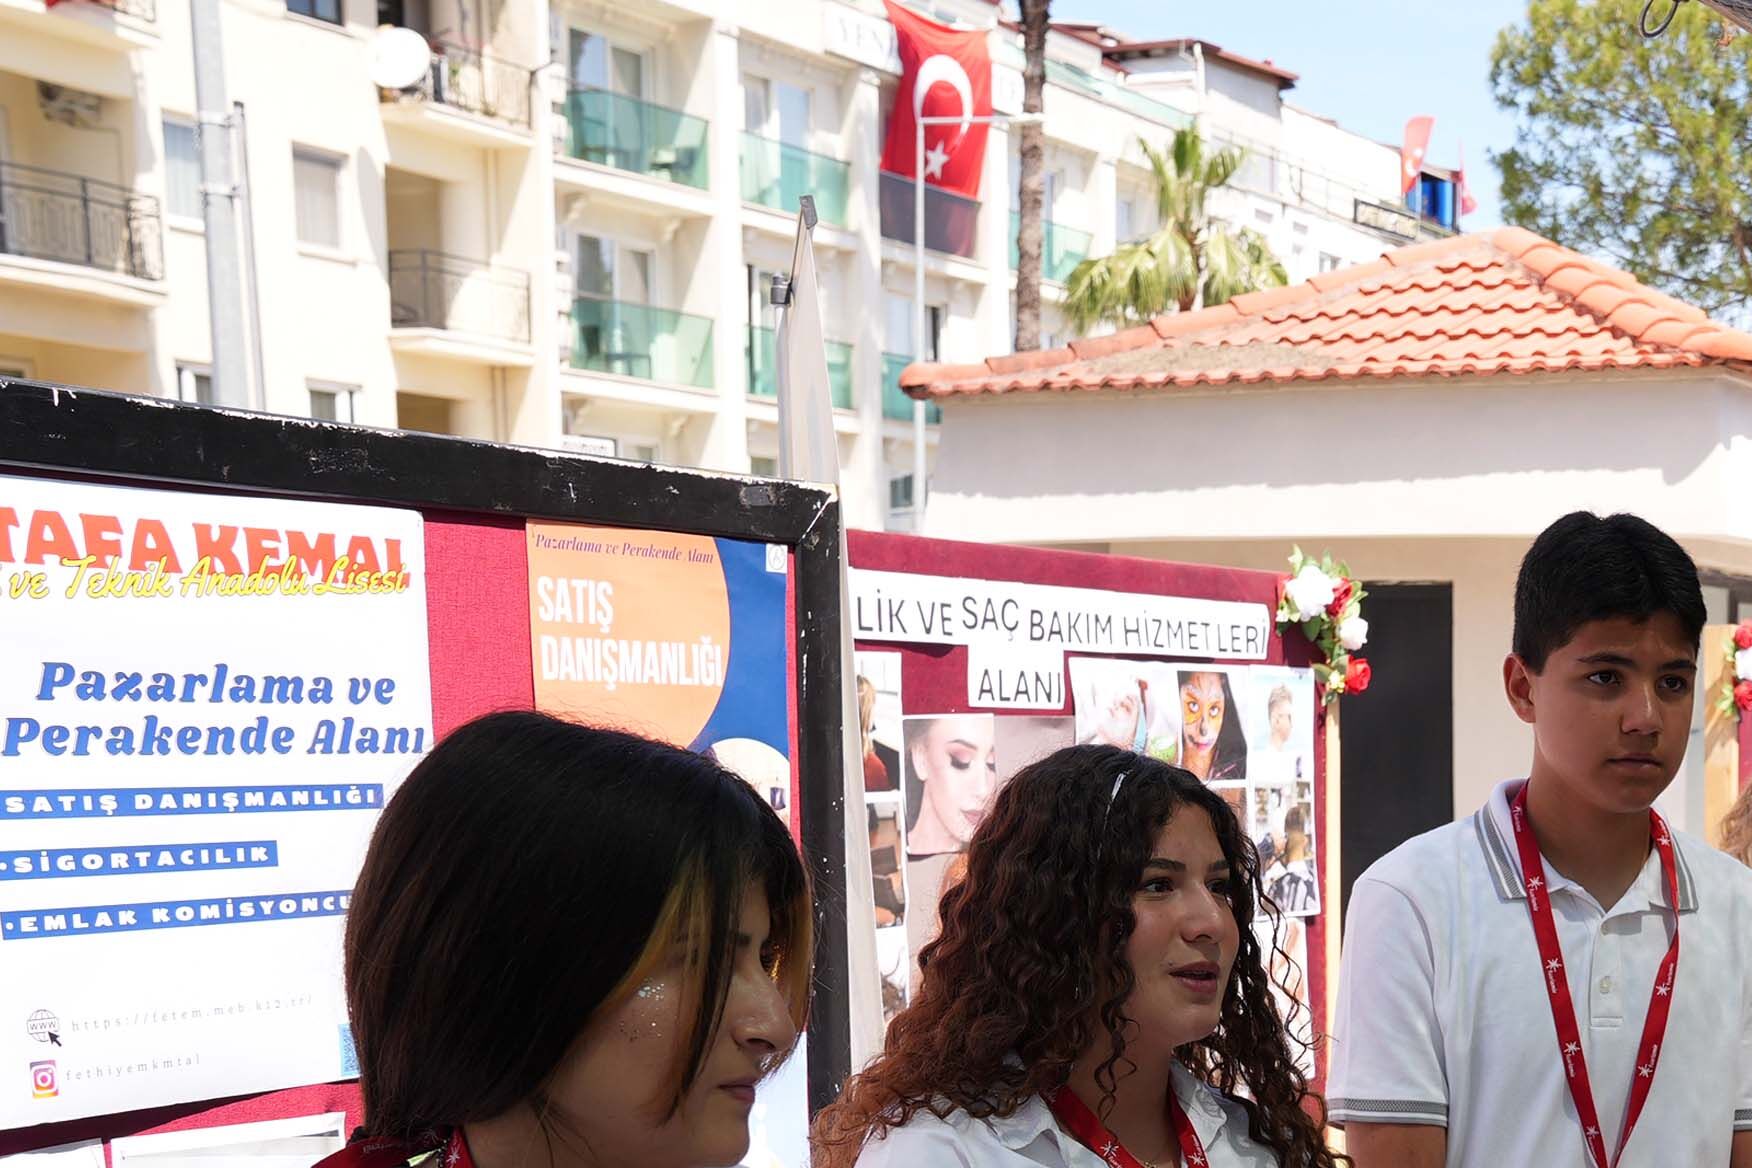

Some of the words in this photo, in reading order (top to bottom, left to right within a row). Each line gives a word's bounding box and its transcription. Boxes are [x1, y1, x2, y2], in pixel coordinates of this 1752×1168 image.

[192, 523, 411, 588] KEMAL
[535, 533, 601, 553] Pazarlama
[605, 544, 619, 555] ve
[621, 543, 682, 561] Perakende
[9, 570, 49, 600] ve
[61, 553, 173, 599] Teknik
[180, 555, 310, 597] Anadolu
[314, 554, 409, 596] Lisesi
[537, 576, 613, 633] SATIŞ
[856, 588, 905, 635] LİK
[916, 602, 953, 637] VE
[962, 596, 1020, 642] SAÇ
[1030, 609, 1113, 645] BAKIM
[36, 662, 333, 704] Pazarlama
[348, 677, 395, 704] ve
[540, 634, 722, 691] DANIŞMANLIĞI
[977, 668, 1062, 703] ALANI
[1, 715, 295, 757] Perakende
[306, 717, 425, 755] Alanı
[6, 795, 118, 816] SATIŞ
[134, 785, 375, 812] DANIŞMANLIĞI
[14, 846, 269, 874] SİGORTACILIK
[20, 910, 138, 933] EMLAK
